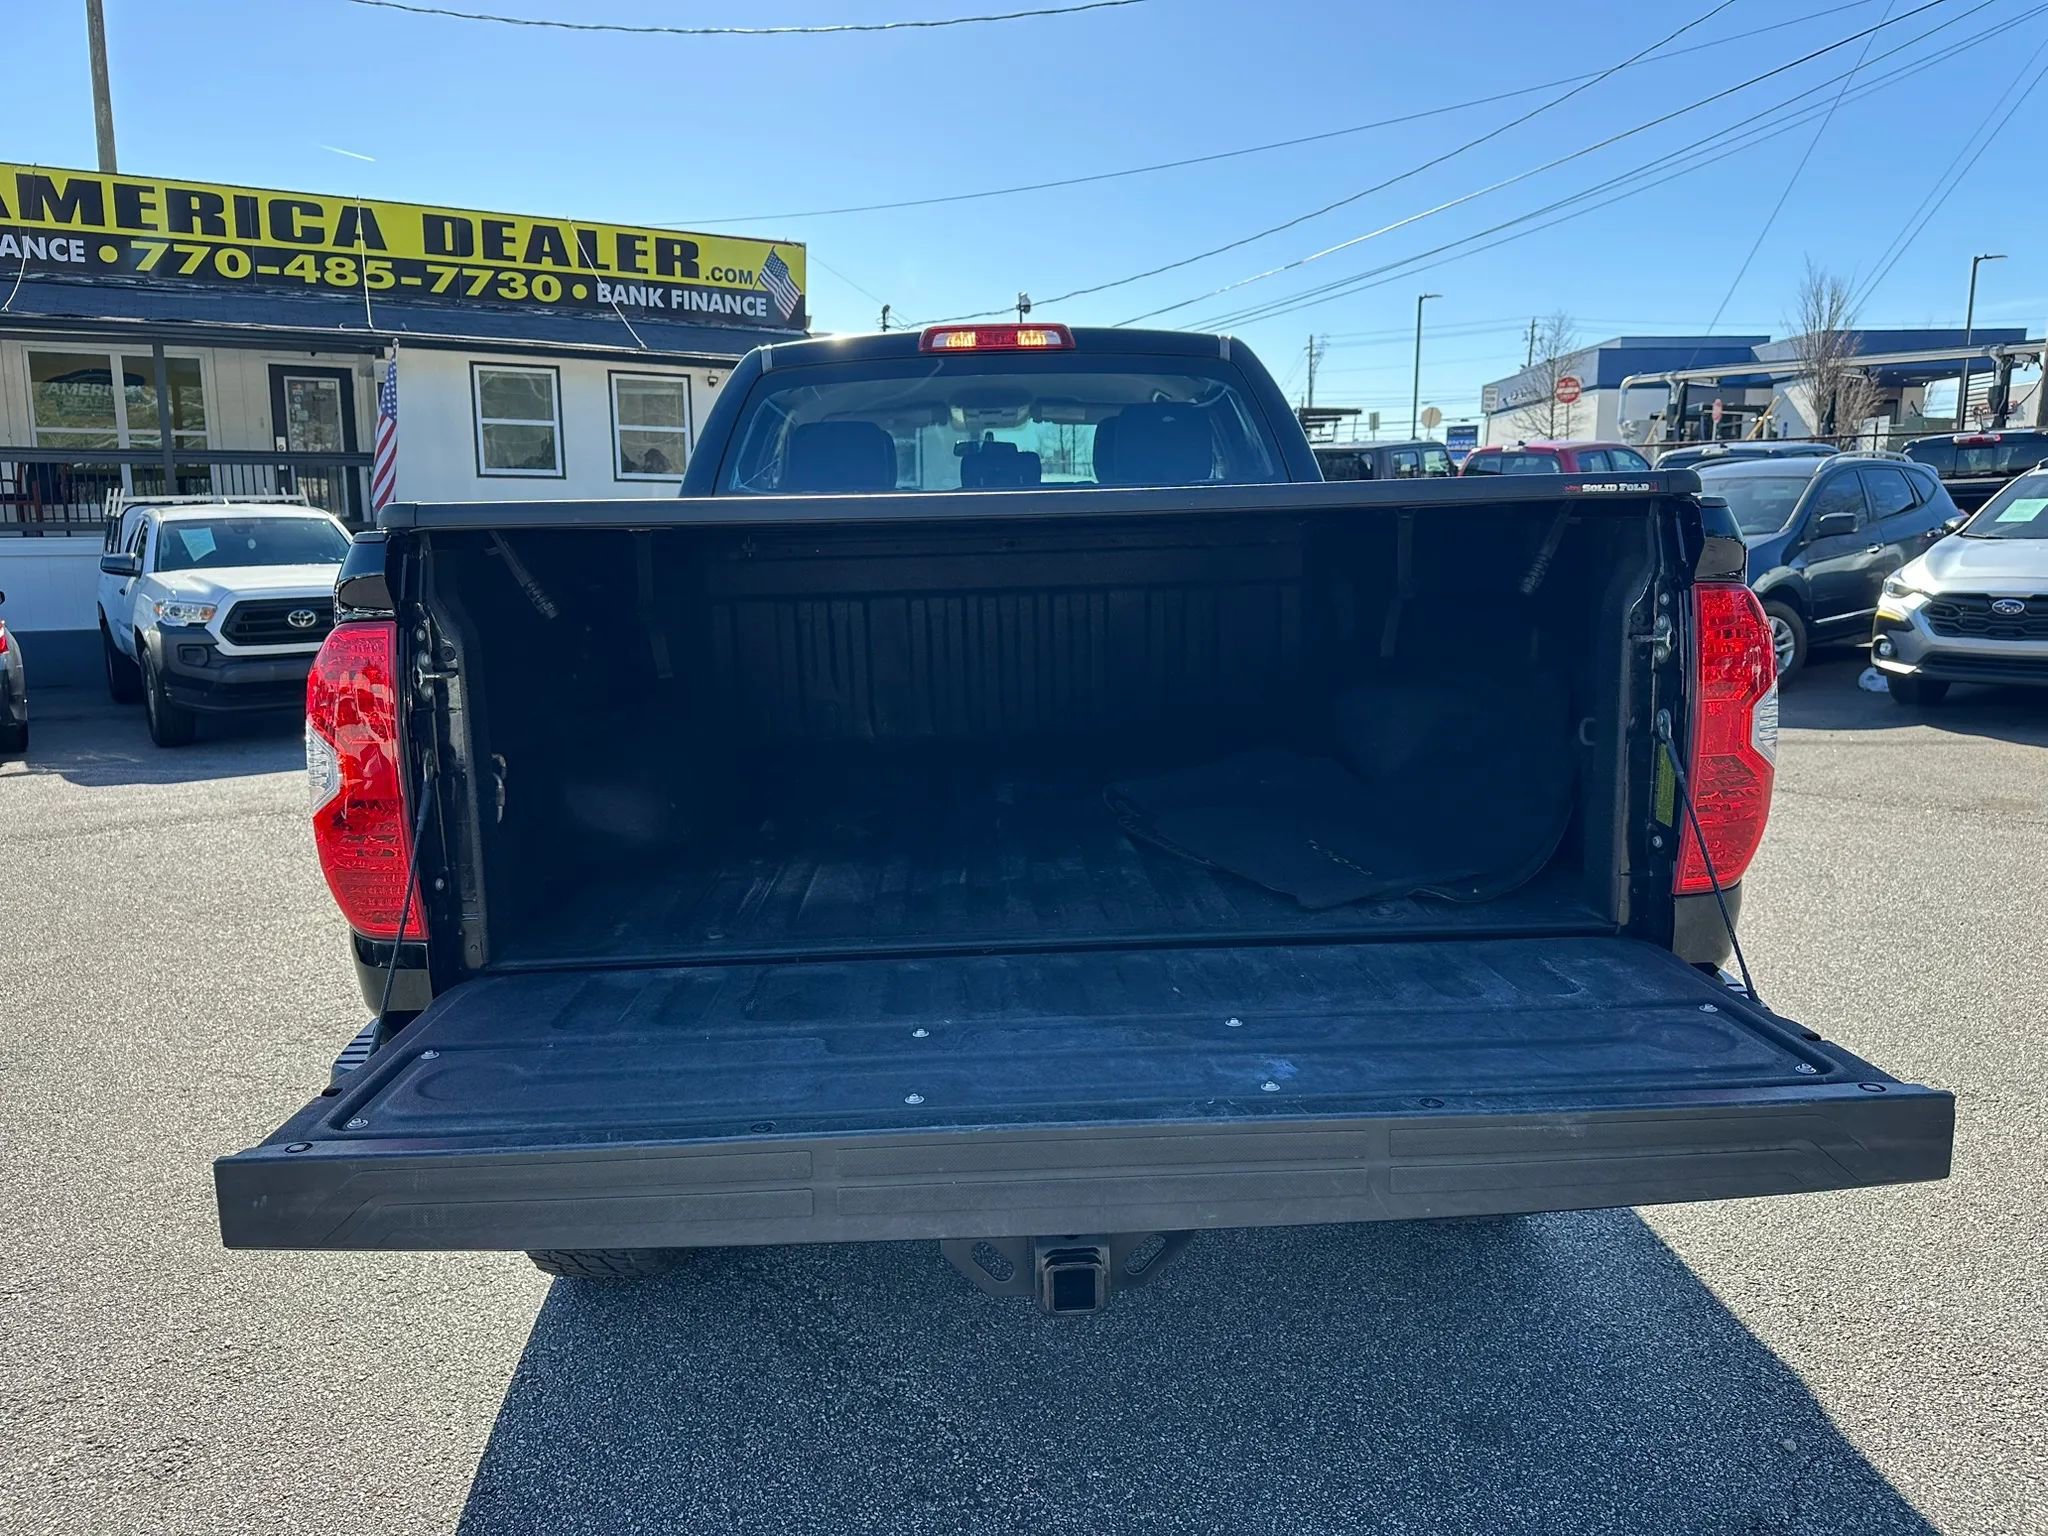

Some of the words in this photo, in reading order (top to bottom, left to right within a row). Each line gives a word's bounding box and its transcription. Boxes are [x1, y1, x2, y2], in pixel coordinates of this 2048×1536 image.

[0, 173, 387, 251] MERICA
[422, 213, 699, 279] DEALER
[130, 240, 562, 303] 770-485-7730
[596, 282, 665, 308] BANK
[671, 289, 768, 317] FINANCE
[1582, 483, 1618, 492] SOLID
[1619, 482, 1650, 492] FOLD
